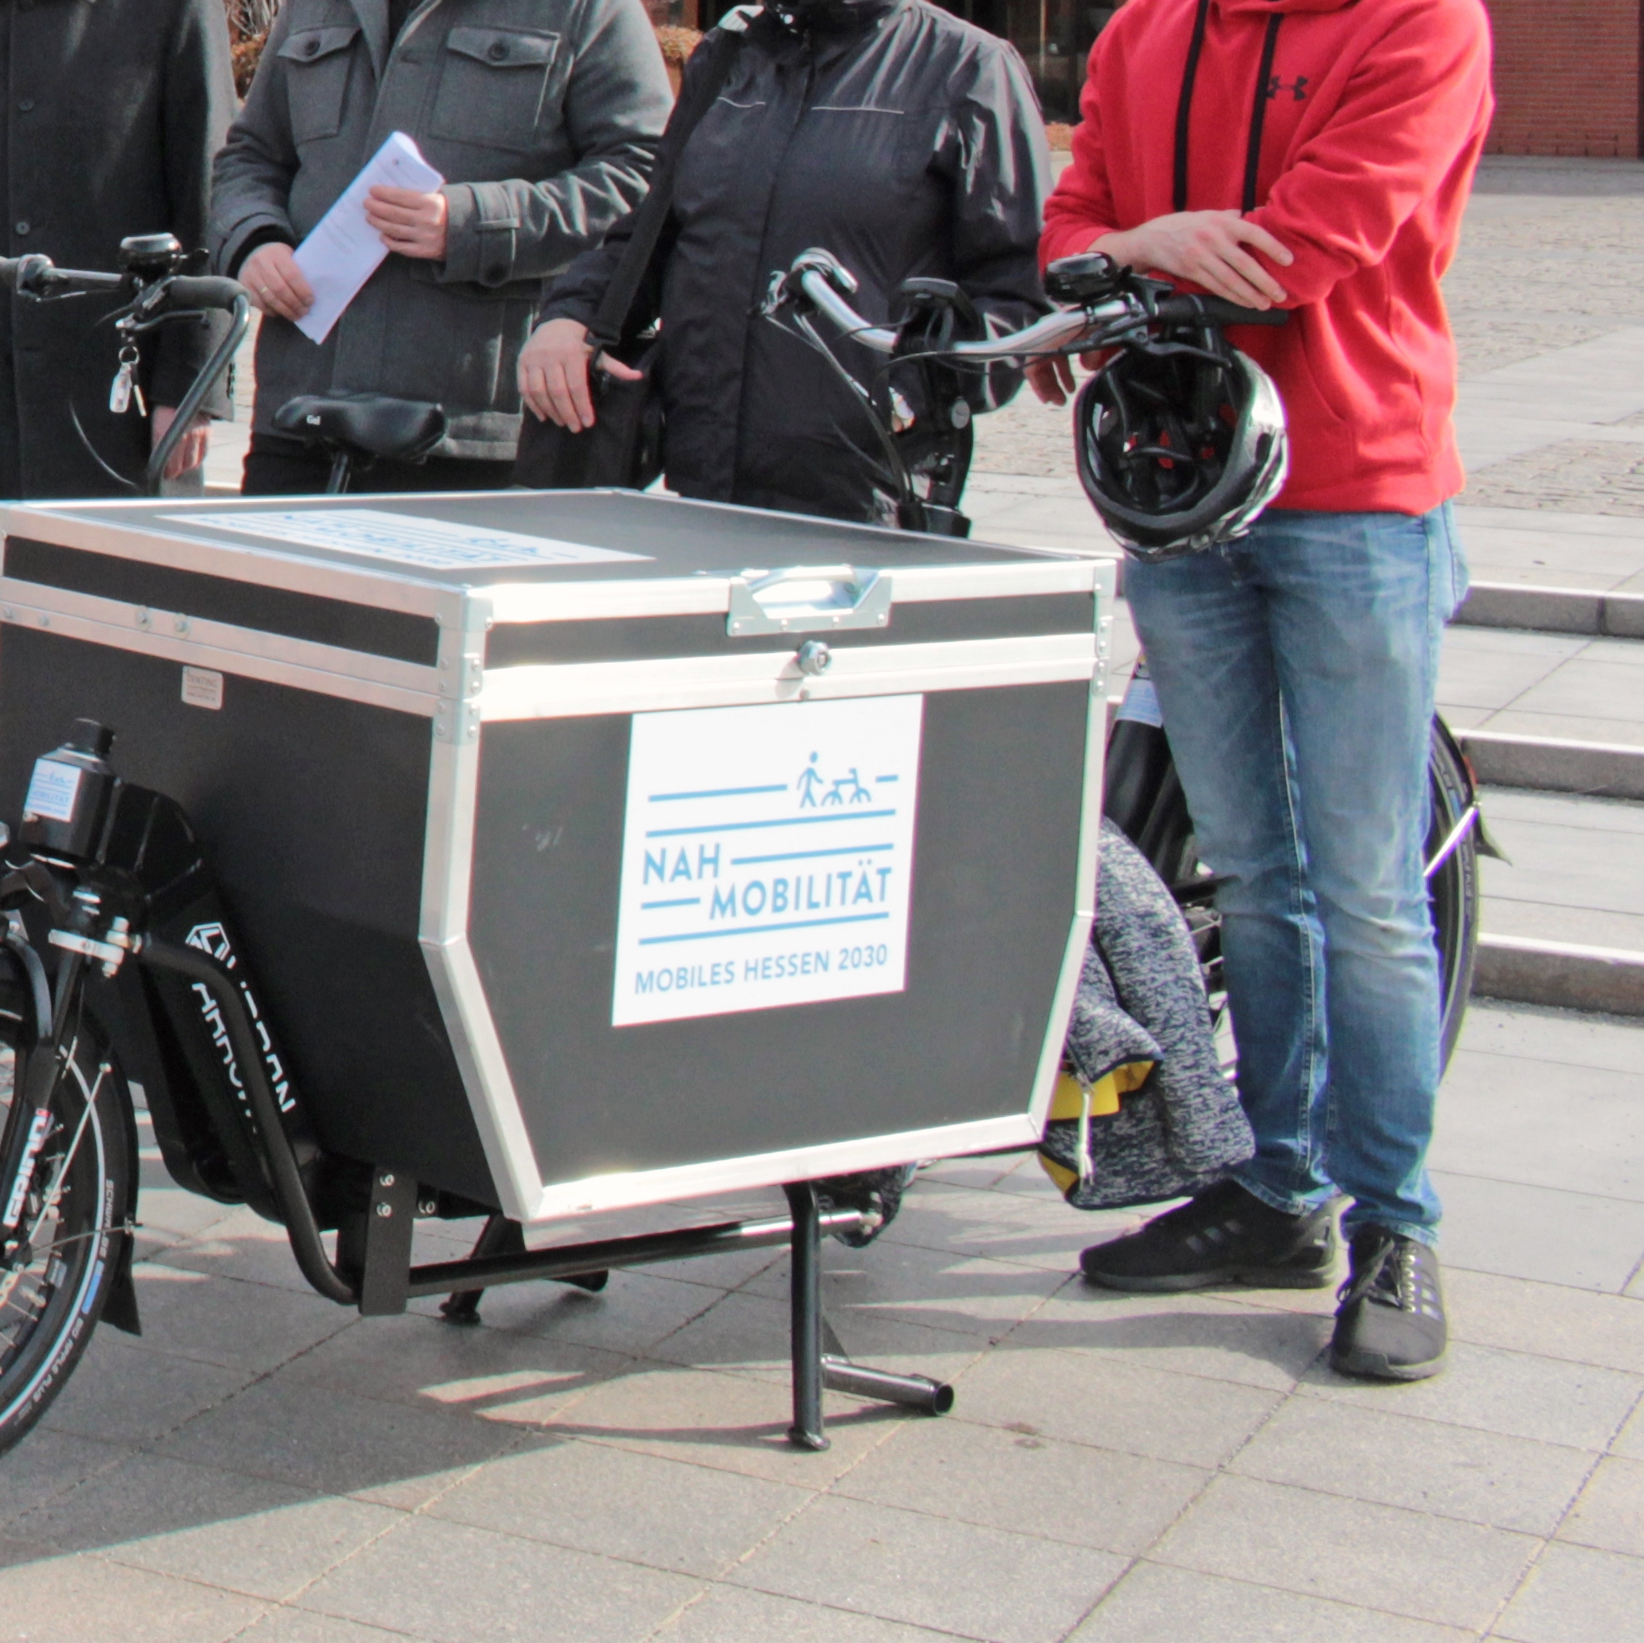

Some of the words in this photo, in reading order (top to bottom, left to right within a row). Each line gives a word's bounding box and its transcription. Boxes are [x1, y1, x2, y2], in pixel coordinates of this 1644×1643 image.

[642, 843, 720, 885] NAH
[709, 858, 892, 921] MOBILITÄT
[634, 960, 735, 995] MOBILES
[743, 950, 831, 983] HESSEN
[837, 943, 888, 971] 2030
[33, 1372, 54, 1403] PLUS
